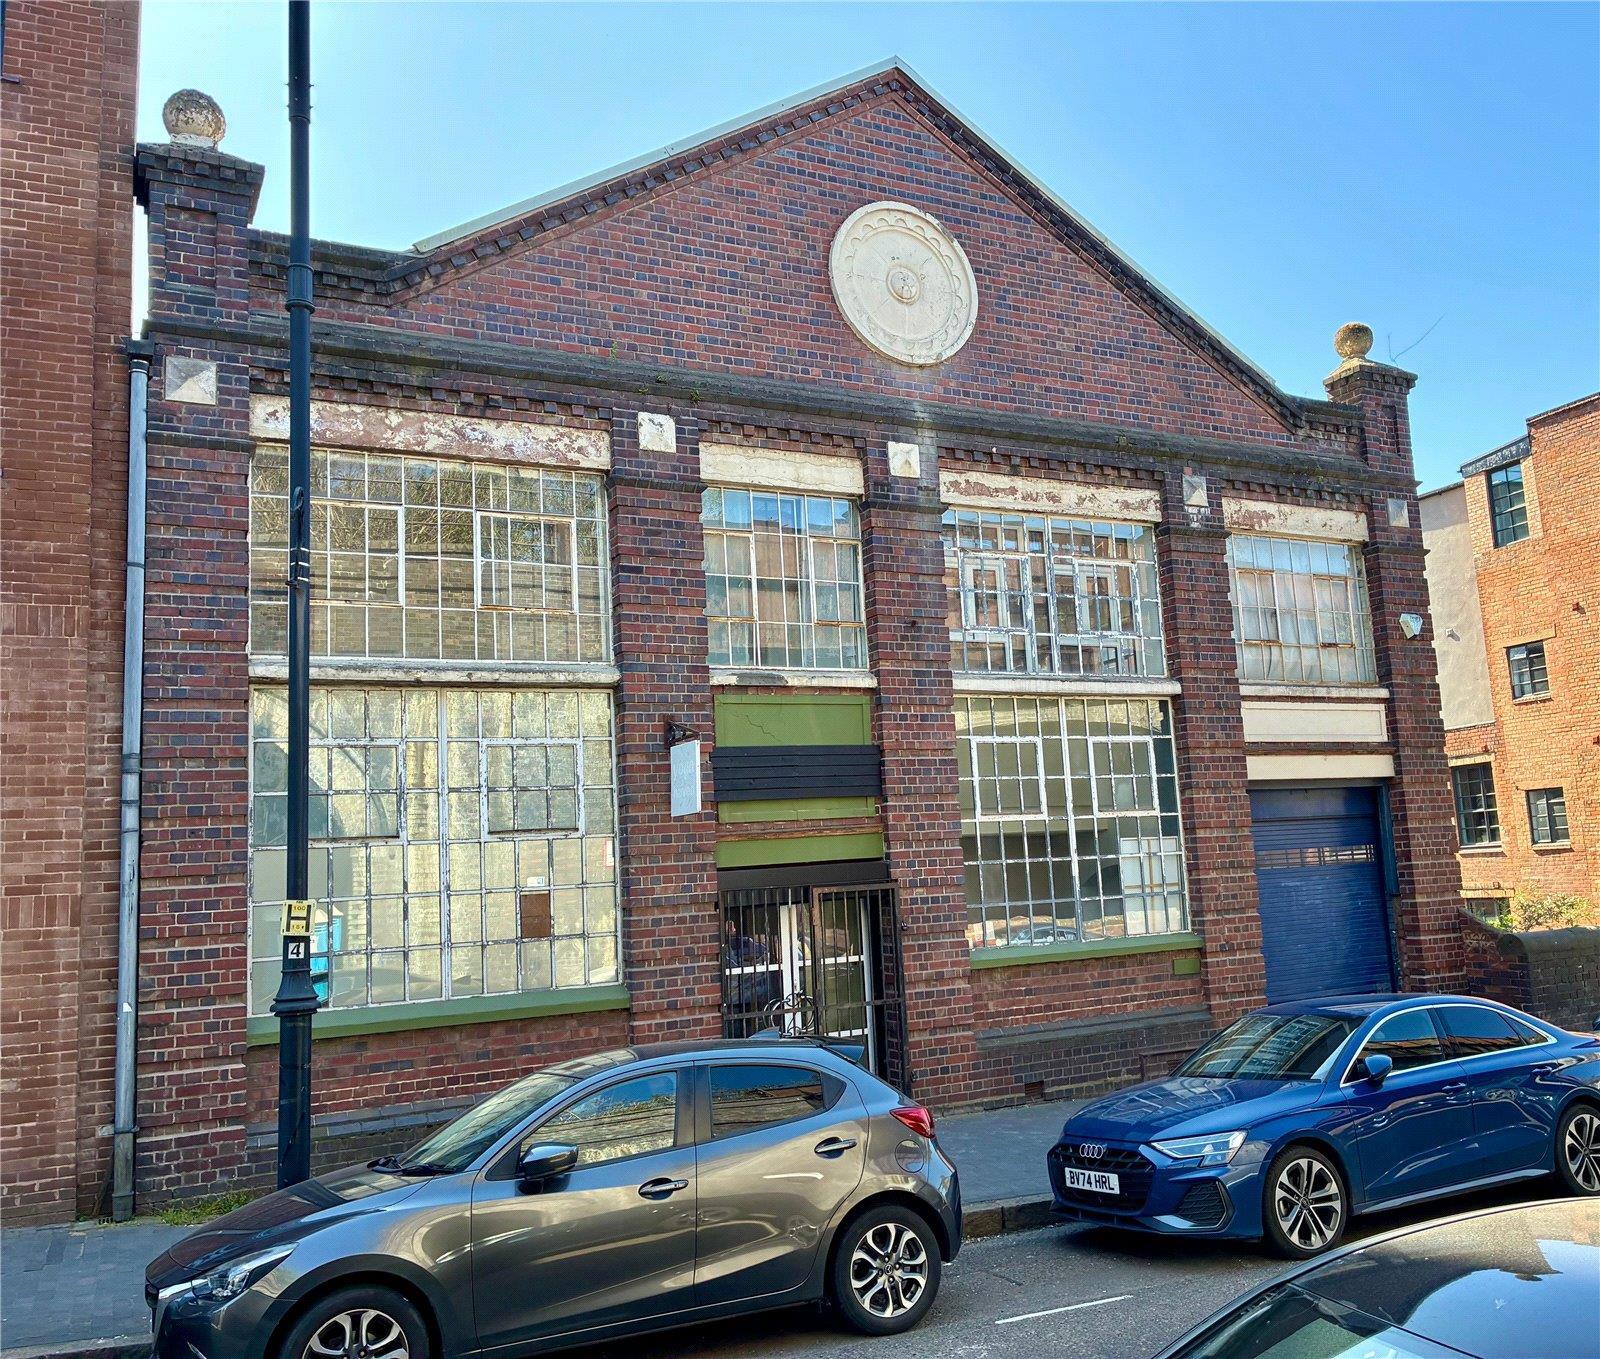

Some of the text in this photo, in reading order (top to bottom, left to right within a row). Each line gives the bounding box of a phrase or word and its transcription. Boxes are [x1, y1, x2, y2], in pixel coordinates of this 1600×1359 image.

[286, 904, 311, 932] H
[291, 942, 301, 957] 4
[1069, 1170, 1114, 1190] BV74 HRL
